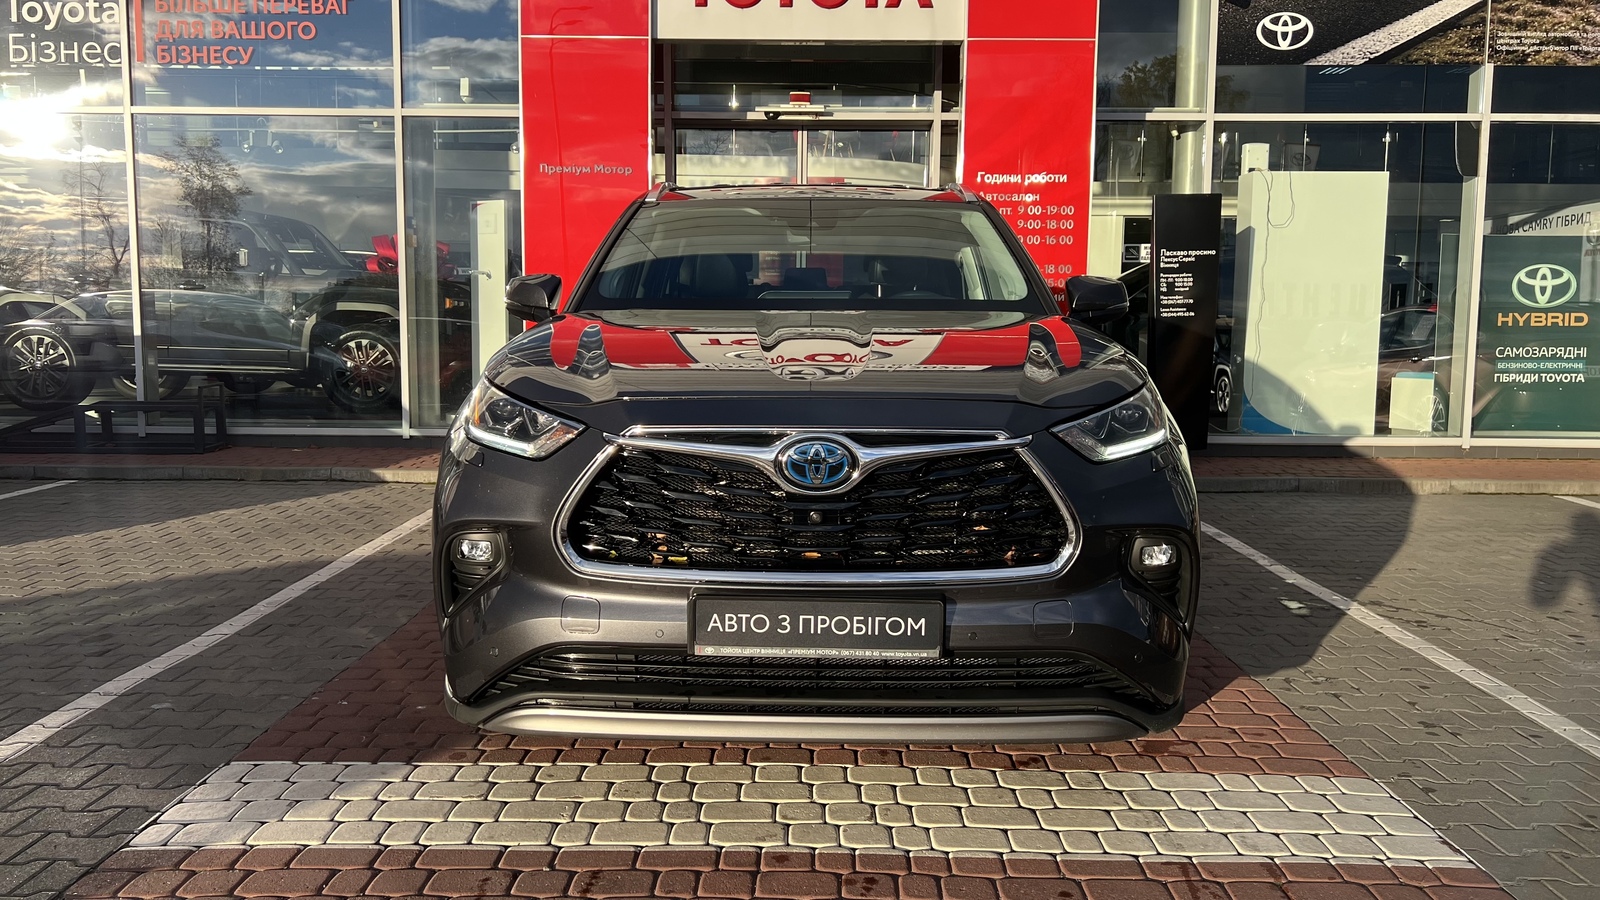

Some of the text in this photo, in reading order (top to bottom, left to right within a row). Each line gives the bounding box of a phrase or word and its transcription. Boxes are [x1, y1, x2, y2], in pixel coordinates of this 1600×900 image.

[155, 0, 349, 15] БІЛЬШЕ ПЕРЕВАГ
[155, 20, 317, 42] ДЛЯ ВАШОГО
[9, 33, 121, 63] Бізнес
[156, 45, 254, 64] БІЗНЕСУ
[540, 163, 633, 176] Преміум Мотор
[977, 172, 1067, 185] Години роботи
[1522, 217, 1554, 232] CAMRY
[1497, 312, 1589, 327] HYBRID
[1495, 346, 1587, 359] САМОЗАРЯДНІ
[1497, 361, 1583, 370] БЕНЗИНОВО-ЕЛЕКТРИЧНІ
[1494, 373, 1585, 384] ГІБРИДИ TOYOTA
[706, 613, 926, 637] АВТО З ПРОБІГОМ
